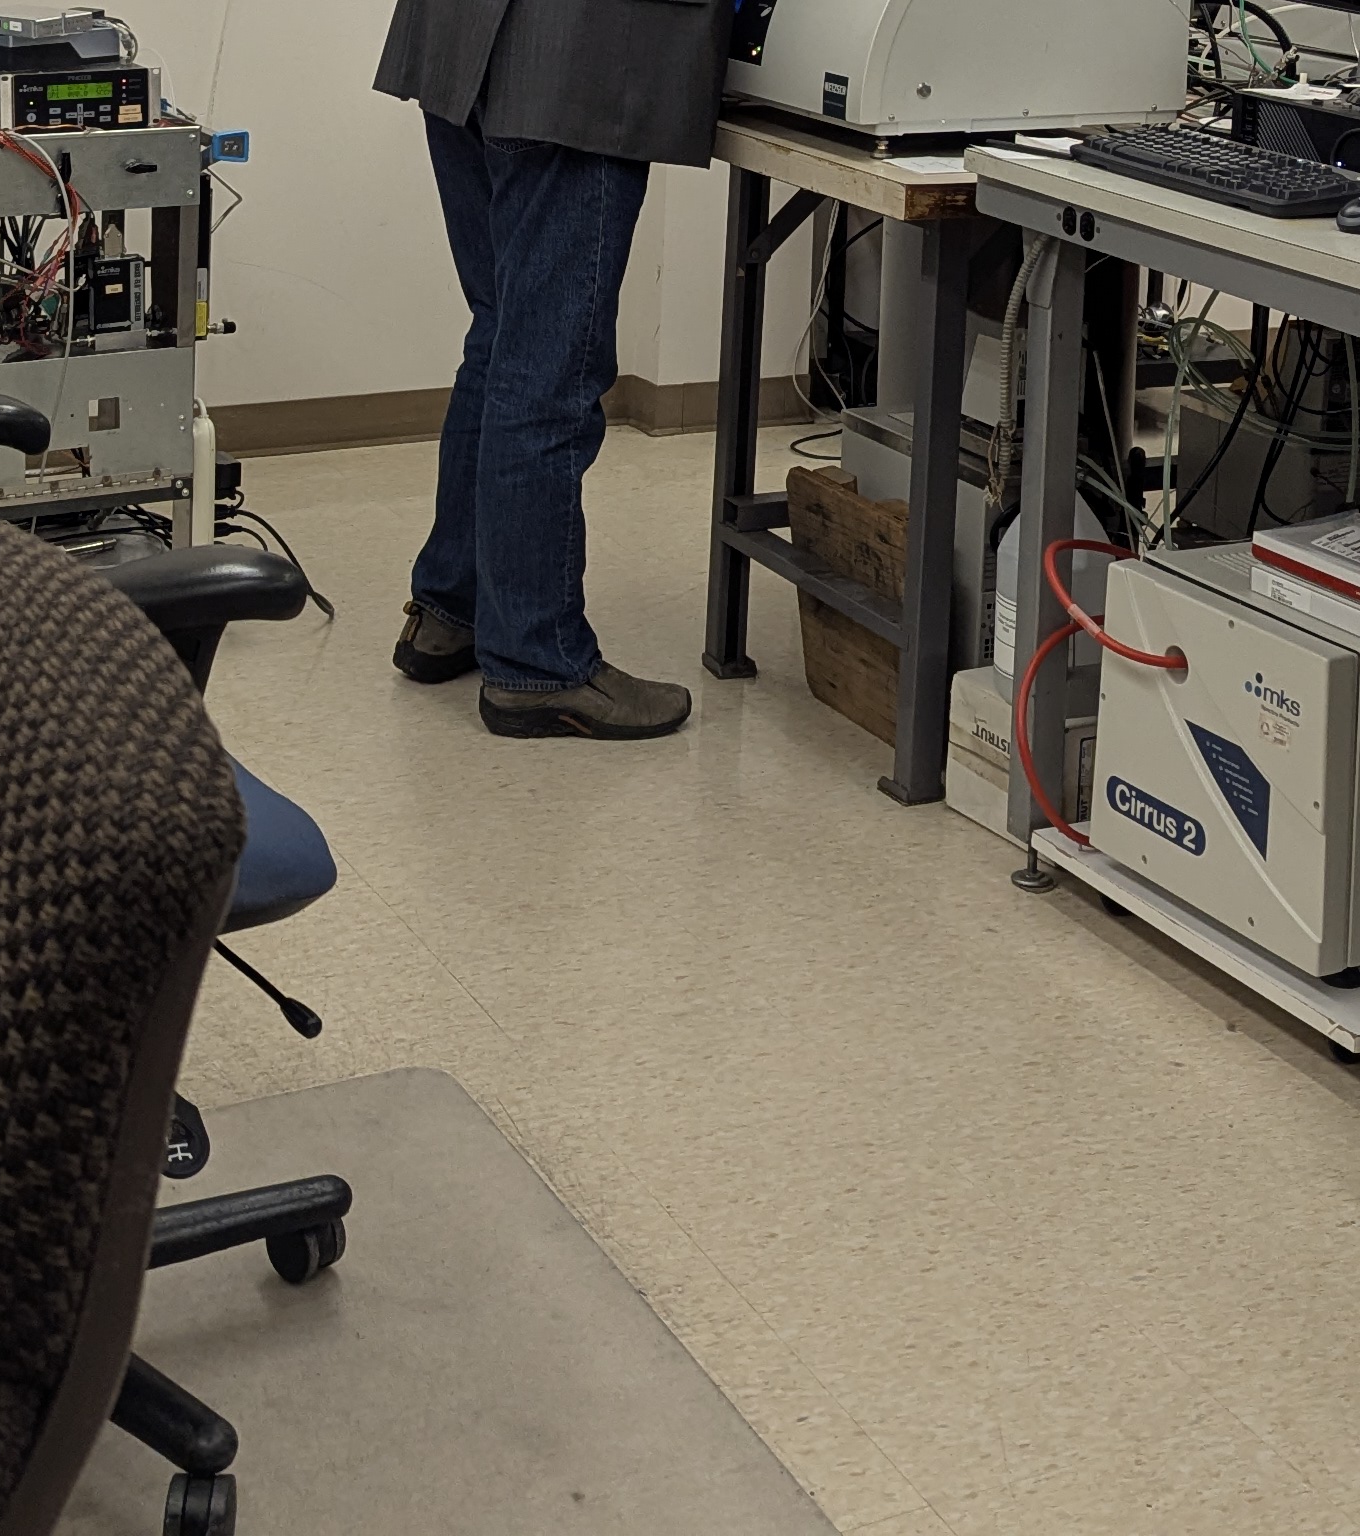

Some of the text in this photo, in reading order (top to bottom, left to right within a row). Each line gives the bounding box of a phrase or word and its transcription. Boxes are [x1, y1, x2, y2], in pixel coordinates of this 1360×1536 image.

[1263, 687, 1301, 717] mks
[971, 723, 1010, 755] ISTRUT
[1115, 783, 1197, 851] Cirrus 2
